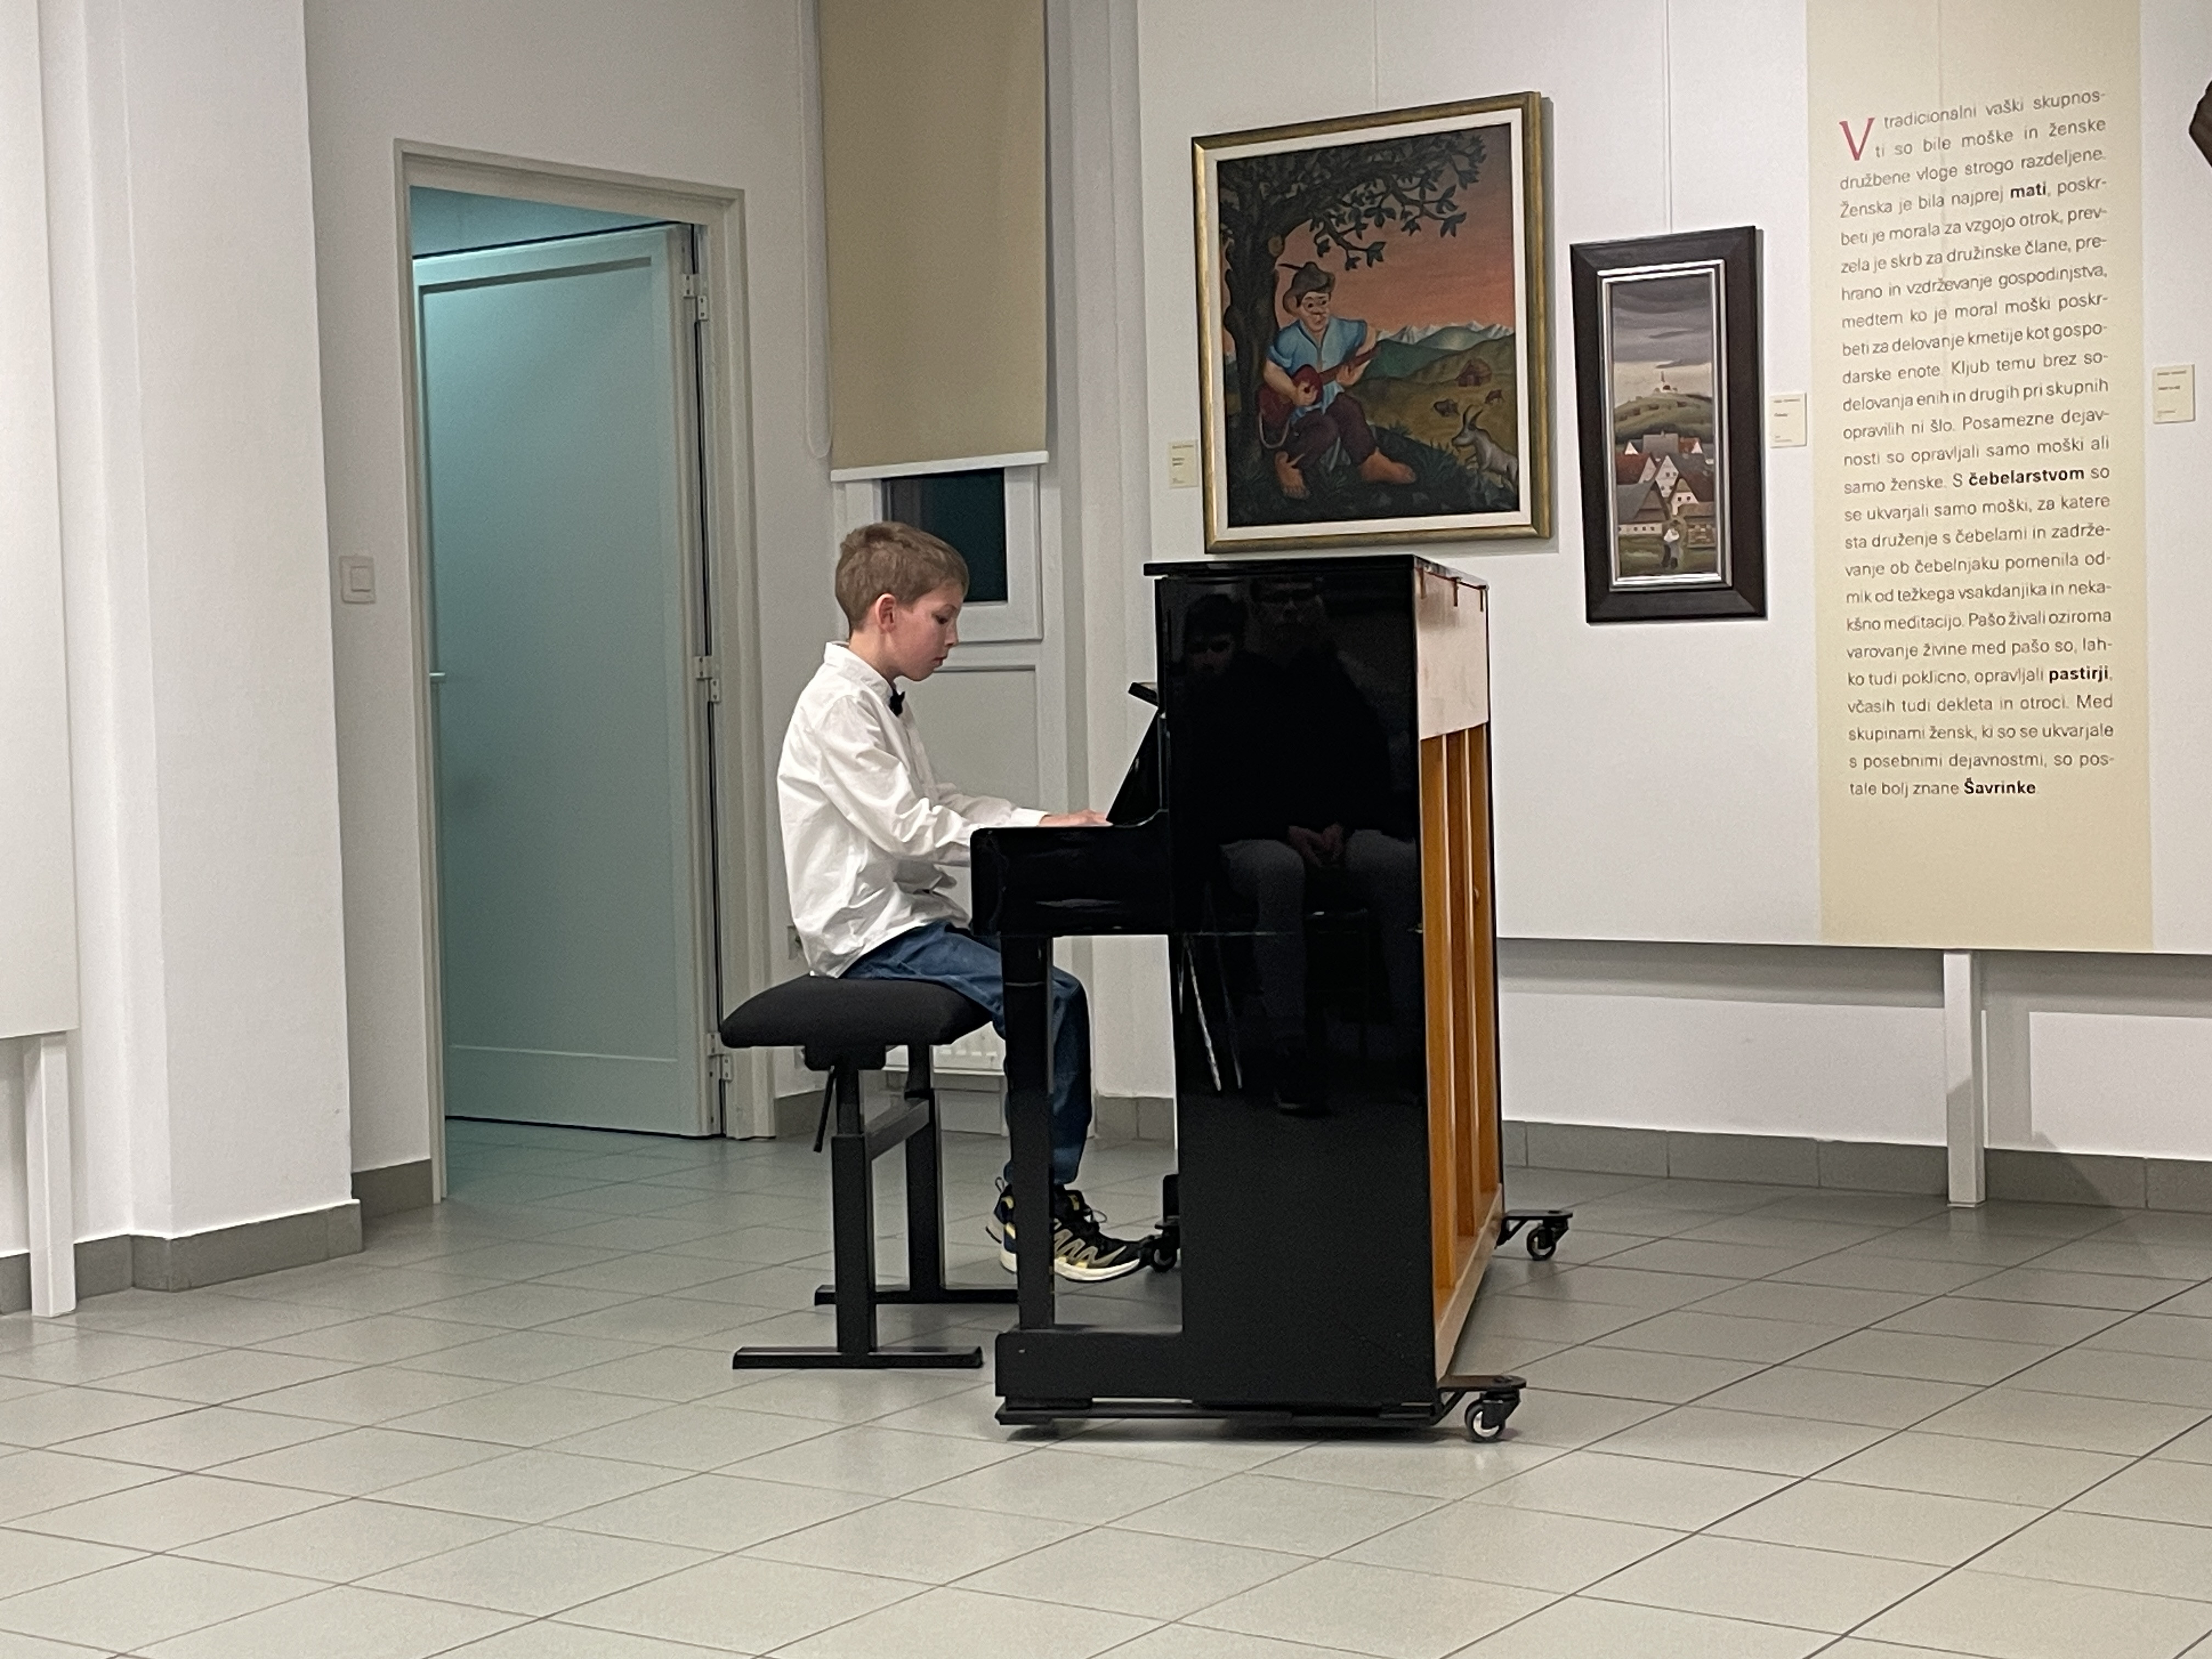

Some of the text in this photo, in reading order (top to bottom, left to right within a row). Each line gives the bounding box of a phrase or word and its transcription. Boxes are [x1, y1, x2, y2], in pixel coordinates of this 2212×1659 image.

[1839, 91, 2105, 161] V tradicionalni vaški skupnos-
[1875, 119, 2106, 158] ti so bile moške in ženske
[1840, 172, 1910, 190] družbene
[1916, 166, 1957, 182] vloge
[1965, 160, 2013, 176] strogo
[1840, 176, 2107, 218] Ženska je bila najprej mati, poskr-
[1841, 207, 2107, 246] beti je morala za vzgojo otrok, prev-
[1841, 237, 2107, 274] zela je skrb za družinske člane, pre-
[1842, 266, 2107, 301] hrano in vzdrževanje gospodinjstva,
[1842, 292, 2108, 328] medtem ko je moral moški poskr-
[1843, 324, 2107, 356] beti za delovanje kmetije kot gospo-
[1843, 368, 1891, 383] darske
[1951, 359, 1990, 377] Kljub
[1996, 358, 2035, 371] temu
[2043, 353, 2076, 368] brez
[2084, 352, 2108, 364] so-
[1843, 378, 2108, 411] delovanja enih in drugih pri skupnih
[1843, 422, 1904, 442] opravilih
[1911, 420, 1923, 434] ni
[1963, 414, 2054, 431] Posamezne
[2061, 409, 2109, 426] dejav-
[1844, 435, 2109, 466] nosti so opravljali samo moški ali
[1844, 481, 1885, 494] samo
[1953, 472, 1962, 488] S
[1968, 470, 2084, 486] čebelarstvom
[2090, 467, 2109, 479] so
[1844, 495, 2110, 522] se ukvarjali samo moški, za katere
[1846, 522, 2111, 549] sta druženje s čebelami in zadrže-
[1845, 551, 2111, 579] vanje ob čebelnjaku pomenila od-
[1875, 589, 1894, 602] od
[1898, 587, 1955, 603] težkega
[1957, 582, 2047, 599] vsakdanjika
[2051, 583, 2064, 596] in
[2068, 580, 2112, 595] neka-
[1847, 617, 1881, 631] kšno
[1969, 612, 2006, 627] Pašo
[2008, 611, 2045, 625] živali
[2049, 610, 2111, 624] oziroma
[1847, 636, 2112, 660] varovanje živine med pašo so, lah-
[1848, 665, 2113, 687] ko tudi poklicno, opravljali pastirji,
[1848, 693, 2113, 713] včasih tudi dekleta in otroci. Med
[1849, 723, 2113, 743] skupinami žensk, ki so se ukvarjale
[1849, 753, 2114, 770] s posebnimi dejavnostmi, so pos-
[1850, 782, 1877, 795] tale
[1882, 782, 1908, 798] bolj
[1913, 785, 1959, 795] znane
